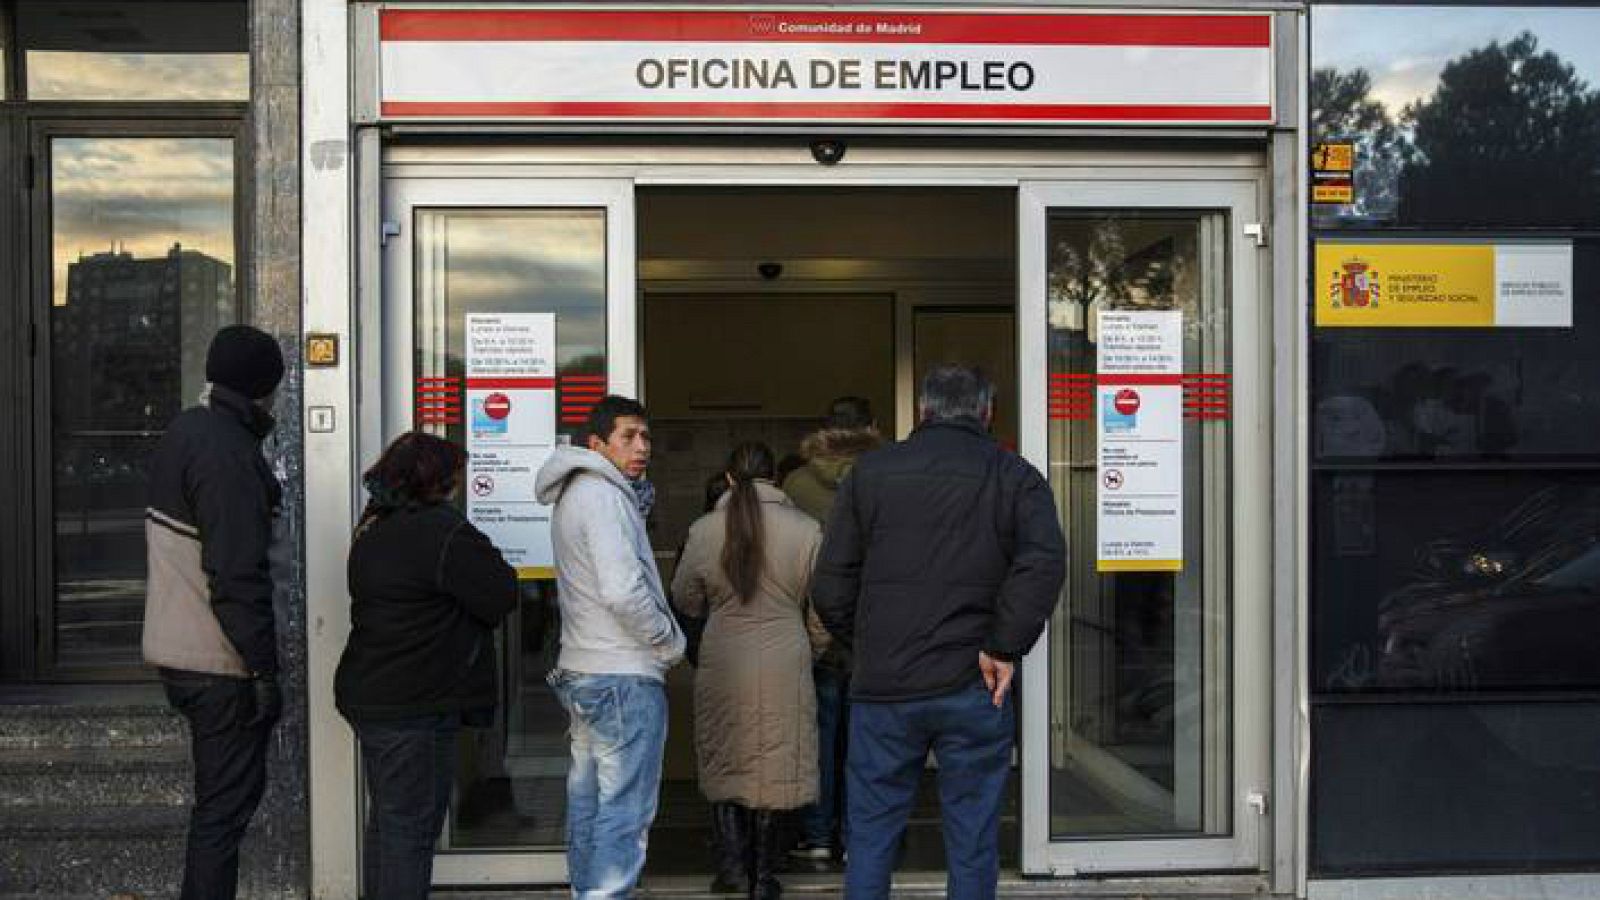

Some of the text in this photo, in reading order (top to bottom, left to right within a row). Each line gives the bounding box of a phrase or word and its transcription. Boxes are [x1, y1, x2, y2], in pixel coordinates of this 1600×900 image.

[778, 21, 922, 35] Comunidad de Madrid
[635, 58, 1036, 92] OFICINA DE EMPLEO
[1387, 273, 1438, 283] MINISTERIO
[1387, 284, 1436, 293] DE EMPLEO
[1397, 294, 1447, 303] SEGURIDAD
[1447, 294, 1479, 303] SOCIAL
